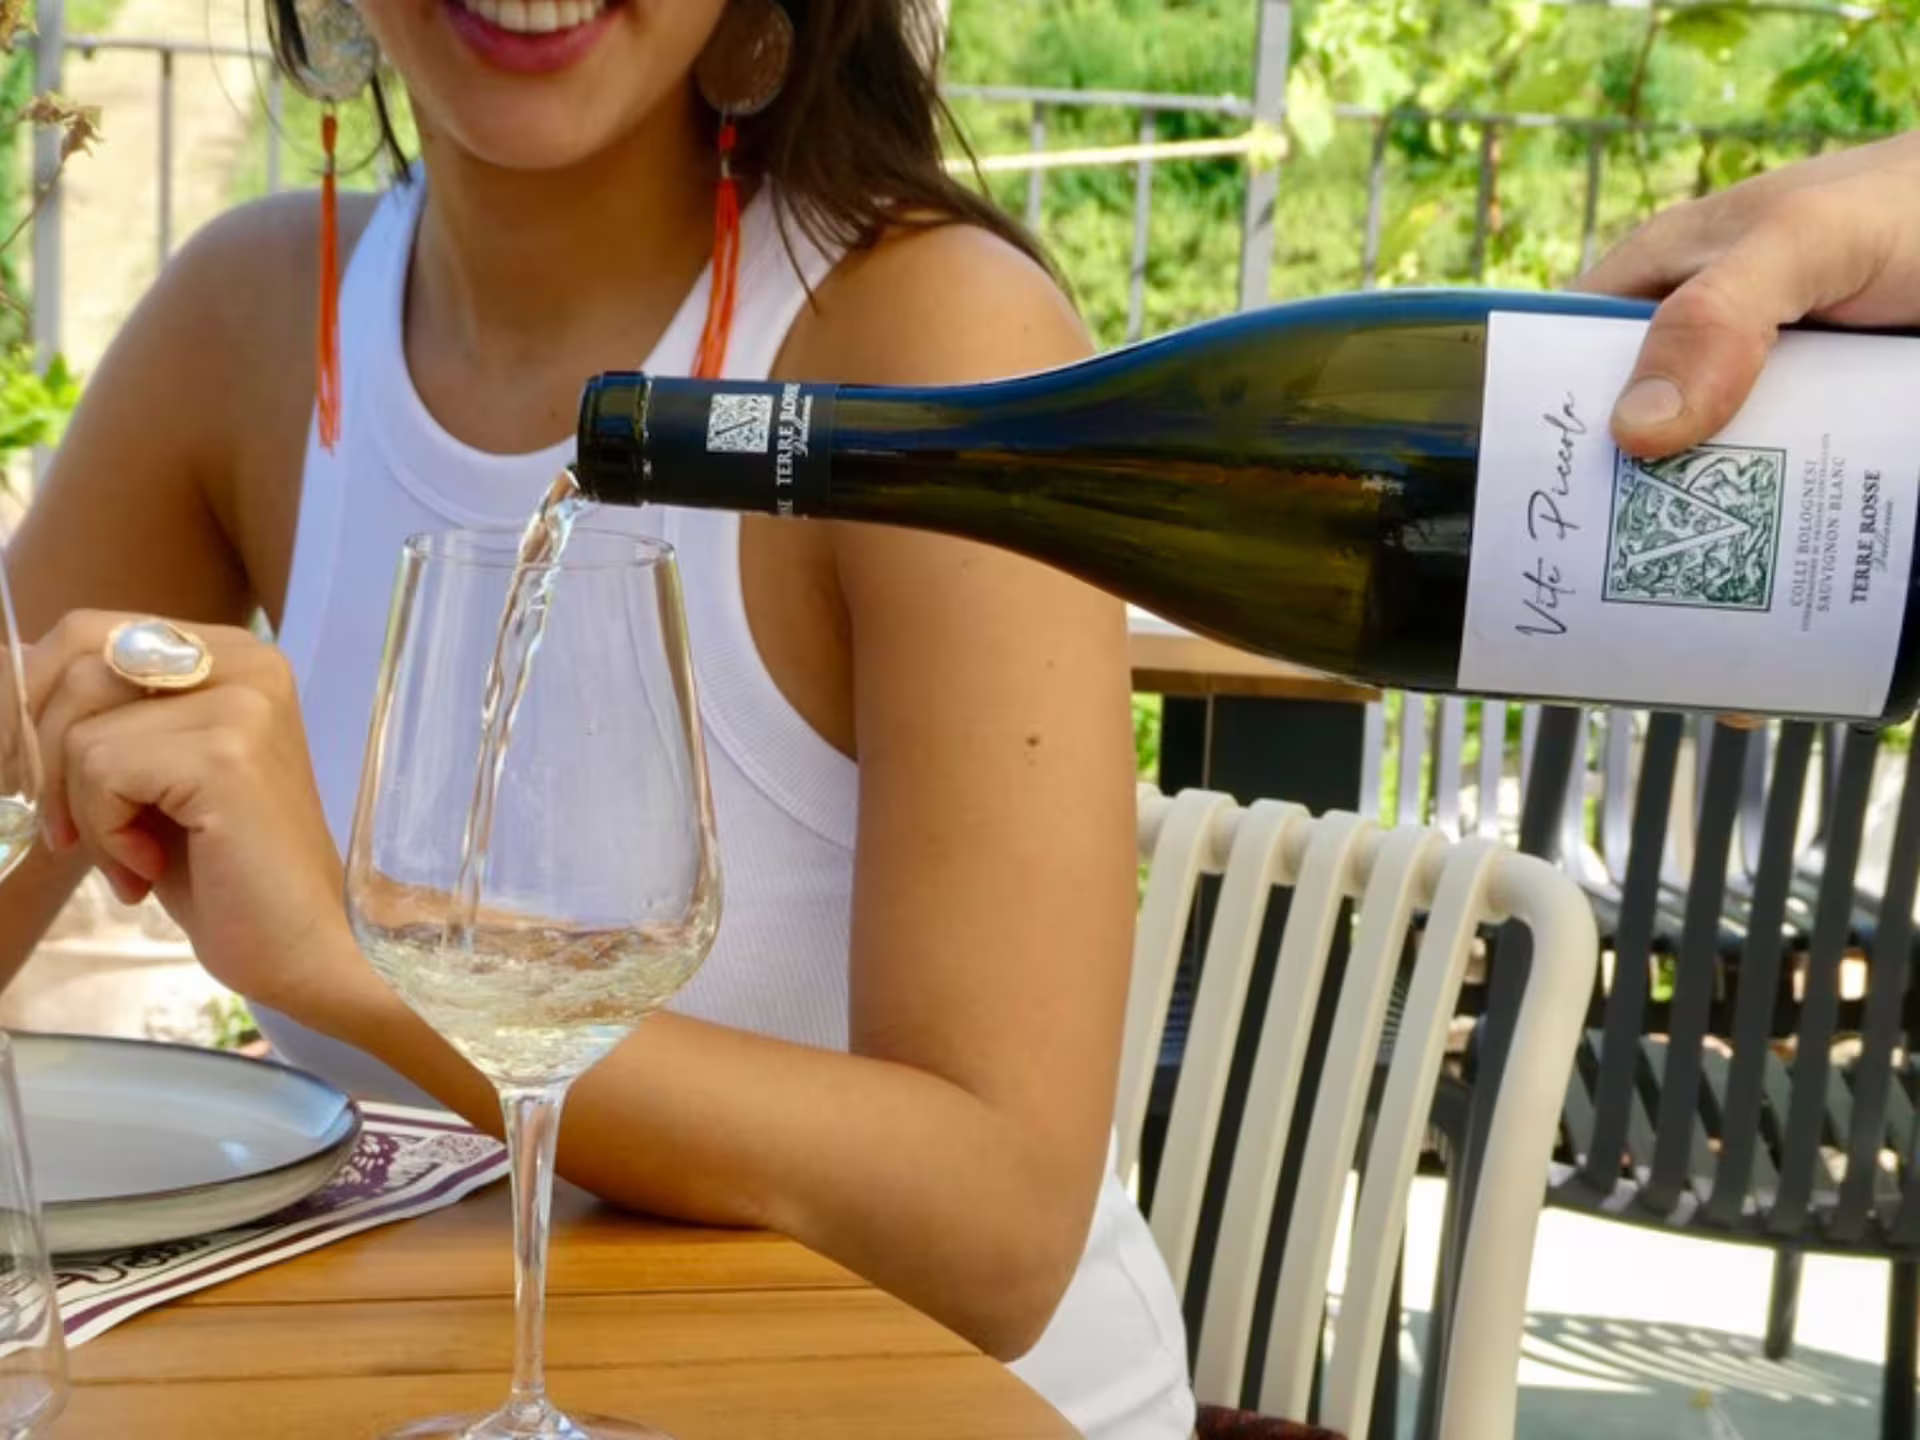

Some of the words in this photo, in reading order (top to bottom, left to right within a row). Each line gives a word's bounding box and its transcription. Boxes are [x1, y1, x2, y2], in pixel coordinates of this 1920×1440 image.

[777, 425, 793, 486] TERRE
[1527, 391, 1587, 540] Piccola
[1827, 456, 1846, 511] BLANC
[1796, 459, 1818, 554] BOLOGNESI
[1858, 469, 1881, 534] ROSSE
[1515, 557, 1576, 637] Vite
[1790, 560, 1807, 608] COLLI
[1816, 517, 1840, 613] SAUVIGNON
[1850, 539, 1875, 604] TERRE
